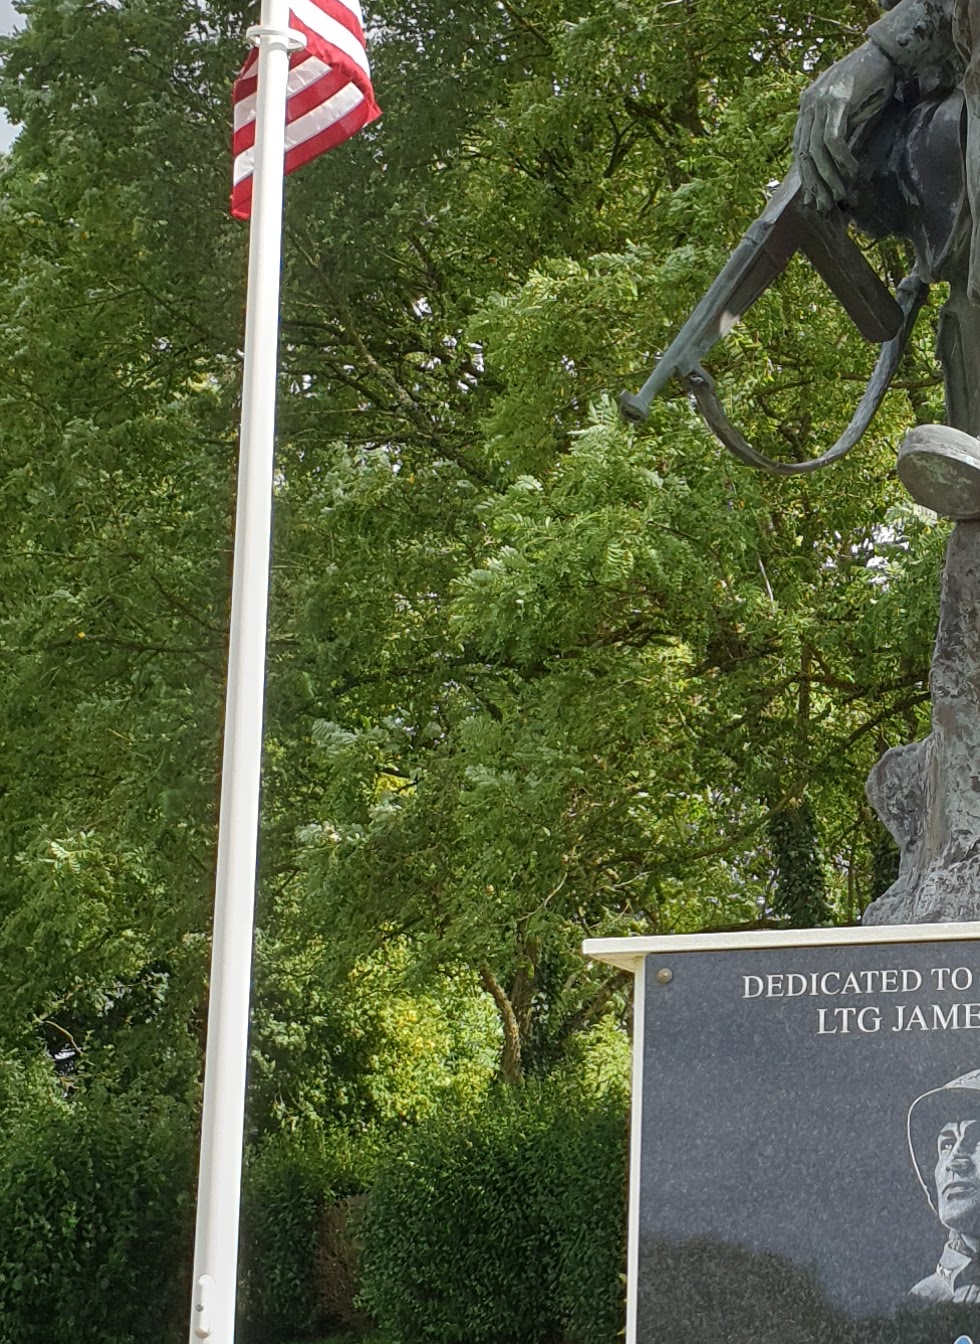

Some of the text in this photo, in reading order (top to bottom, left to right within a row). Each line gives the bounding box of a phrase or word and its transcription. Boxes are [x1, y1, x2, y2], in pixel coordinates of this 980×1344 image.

[742, 969, 922, 999] DEDICATED
[930, 966, 973, 991] TO
[816, 1006, 883, 1035] LTG
